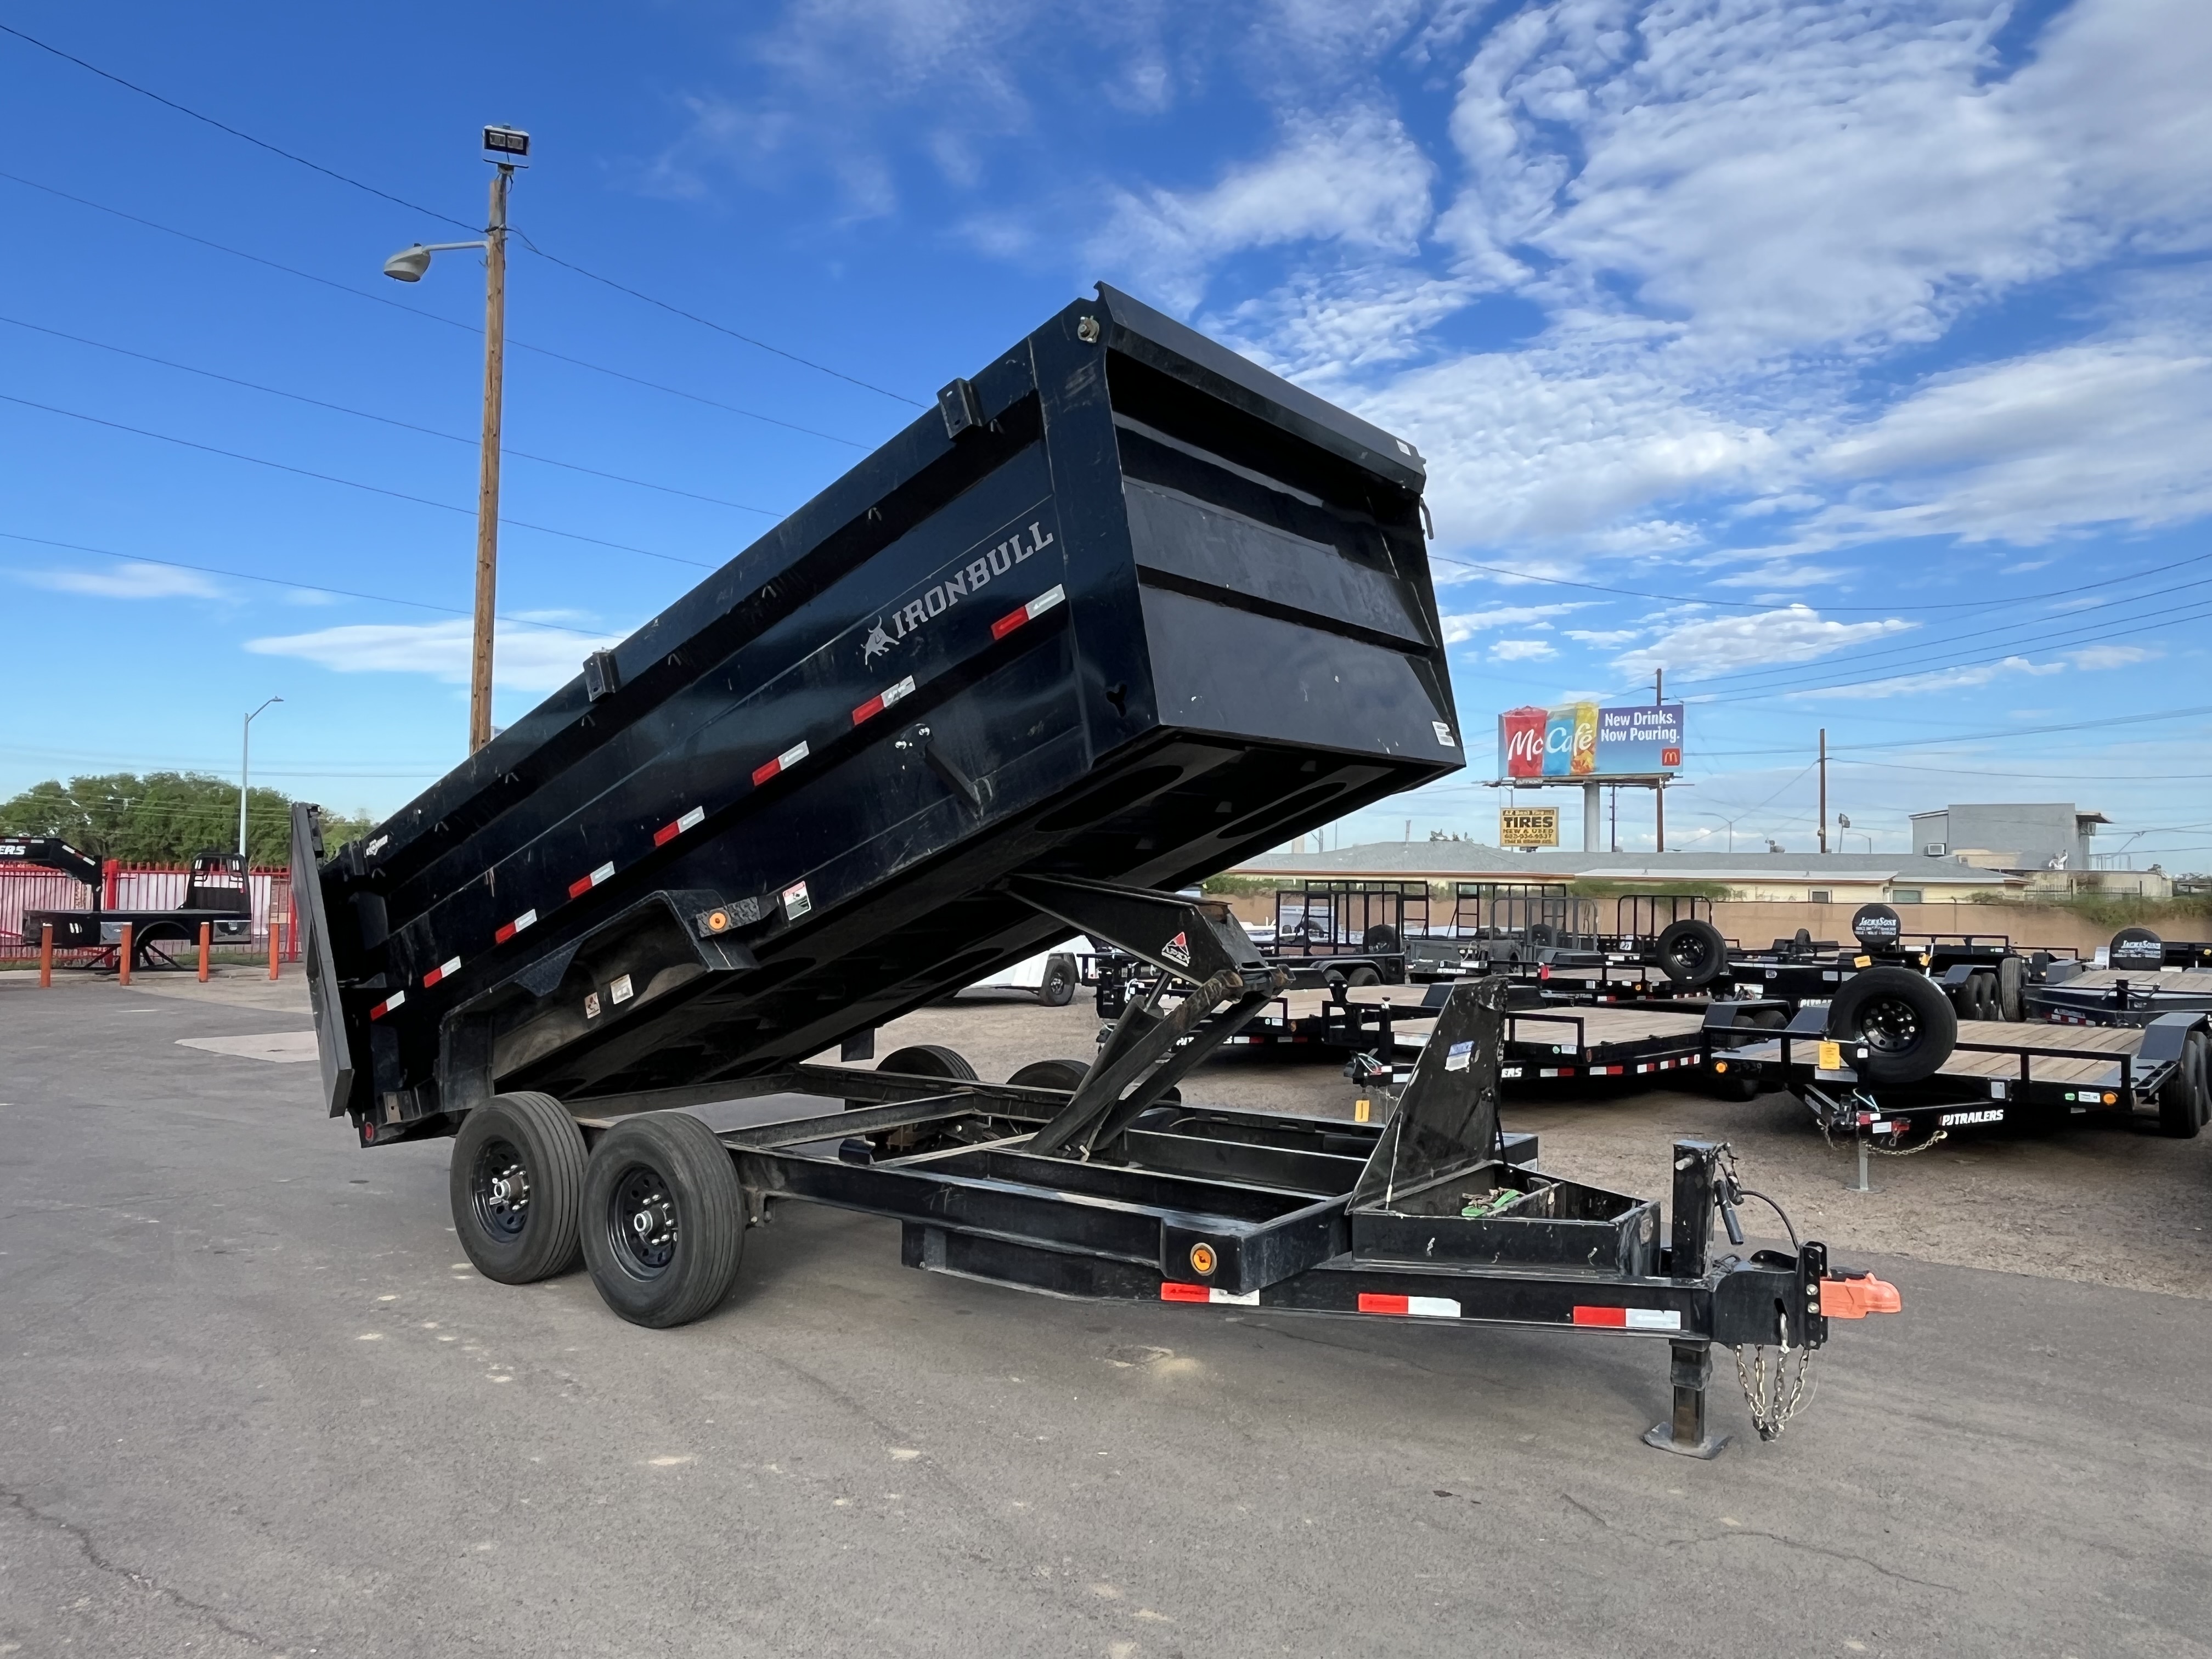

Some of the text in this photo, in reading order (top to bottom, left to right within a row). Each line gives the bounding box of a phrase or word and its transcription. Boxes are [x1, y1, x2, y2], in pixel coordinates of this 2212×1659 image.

[892, 522, 1053, 639] IRONBULL
[1605, 710, 1676, 727] New Drinks.
[1601, 726, 1680, 743] Now Pouring.
[1504, 816, 1553, 828] TIRES
